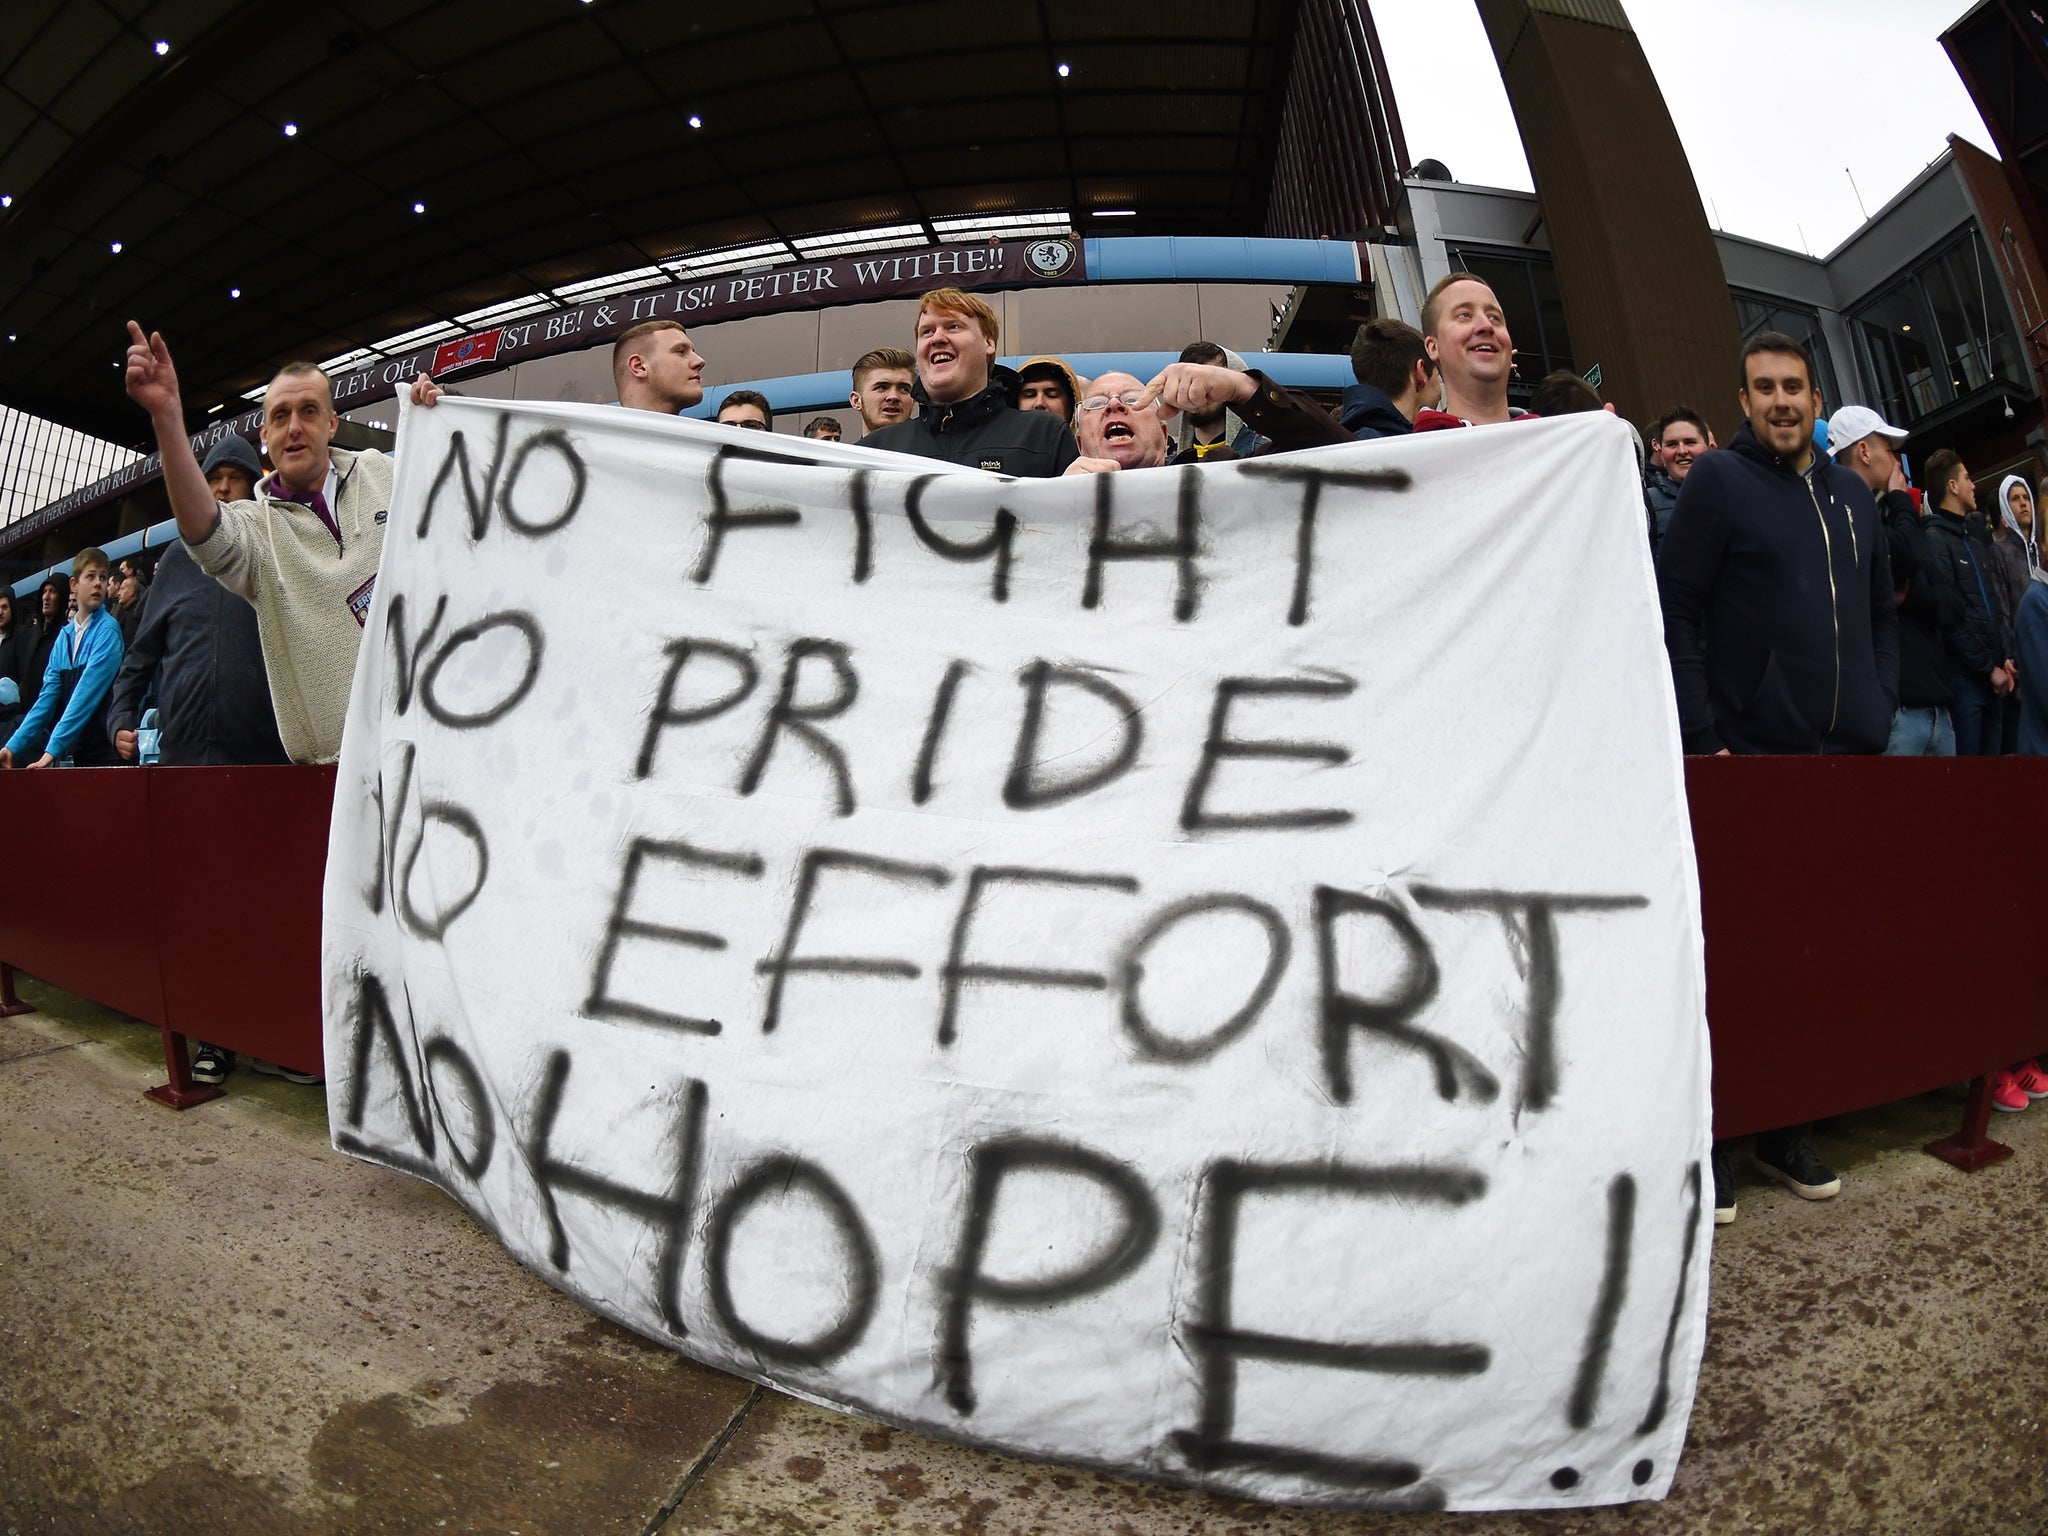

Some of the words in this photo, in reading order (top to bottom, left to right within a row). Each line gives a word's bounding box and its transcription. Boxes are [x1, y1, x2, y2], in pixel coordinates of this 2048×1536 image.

[73, 492, 81, 508] A
[83, 478, 111, 503] GOOD
[112, 463, 137, 489] BALL
[142, 455, 162, 475] PLA
[191, 432, 208, 452] IN
[210, 420, 238, 446] FOR
[244, 409, 265, 433] TO
[334, 370, 376, 399] LEY.
[544, 310, 584, 341] BE!
[593, 305, 619, 328] &
[630, 294, 666, 321] IT
[673, 285, 716, 312] IS!!
[726, 266, 839, 304] PETER
[853, 247, 1004, 286] WITHE!!
[416, 412, 588, 541] NO
[690, 445, 1414, 627] FIGHT
[385, 592, 546, 731] NO
[631, 636, 1360, 836] PRIDE
[372, 741, 490, 941] NO
[582, 835, 1650, 1112] EFFORT
[346, 973, 497, 1182] NO
